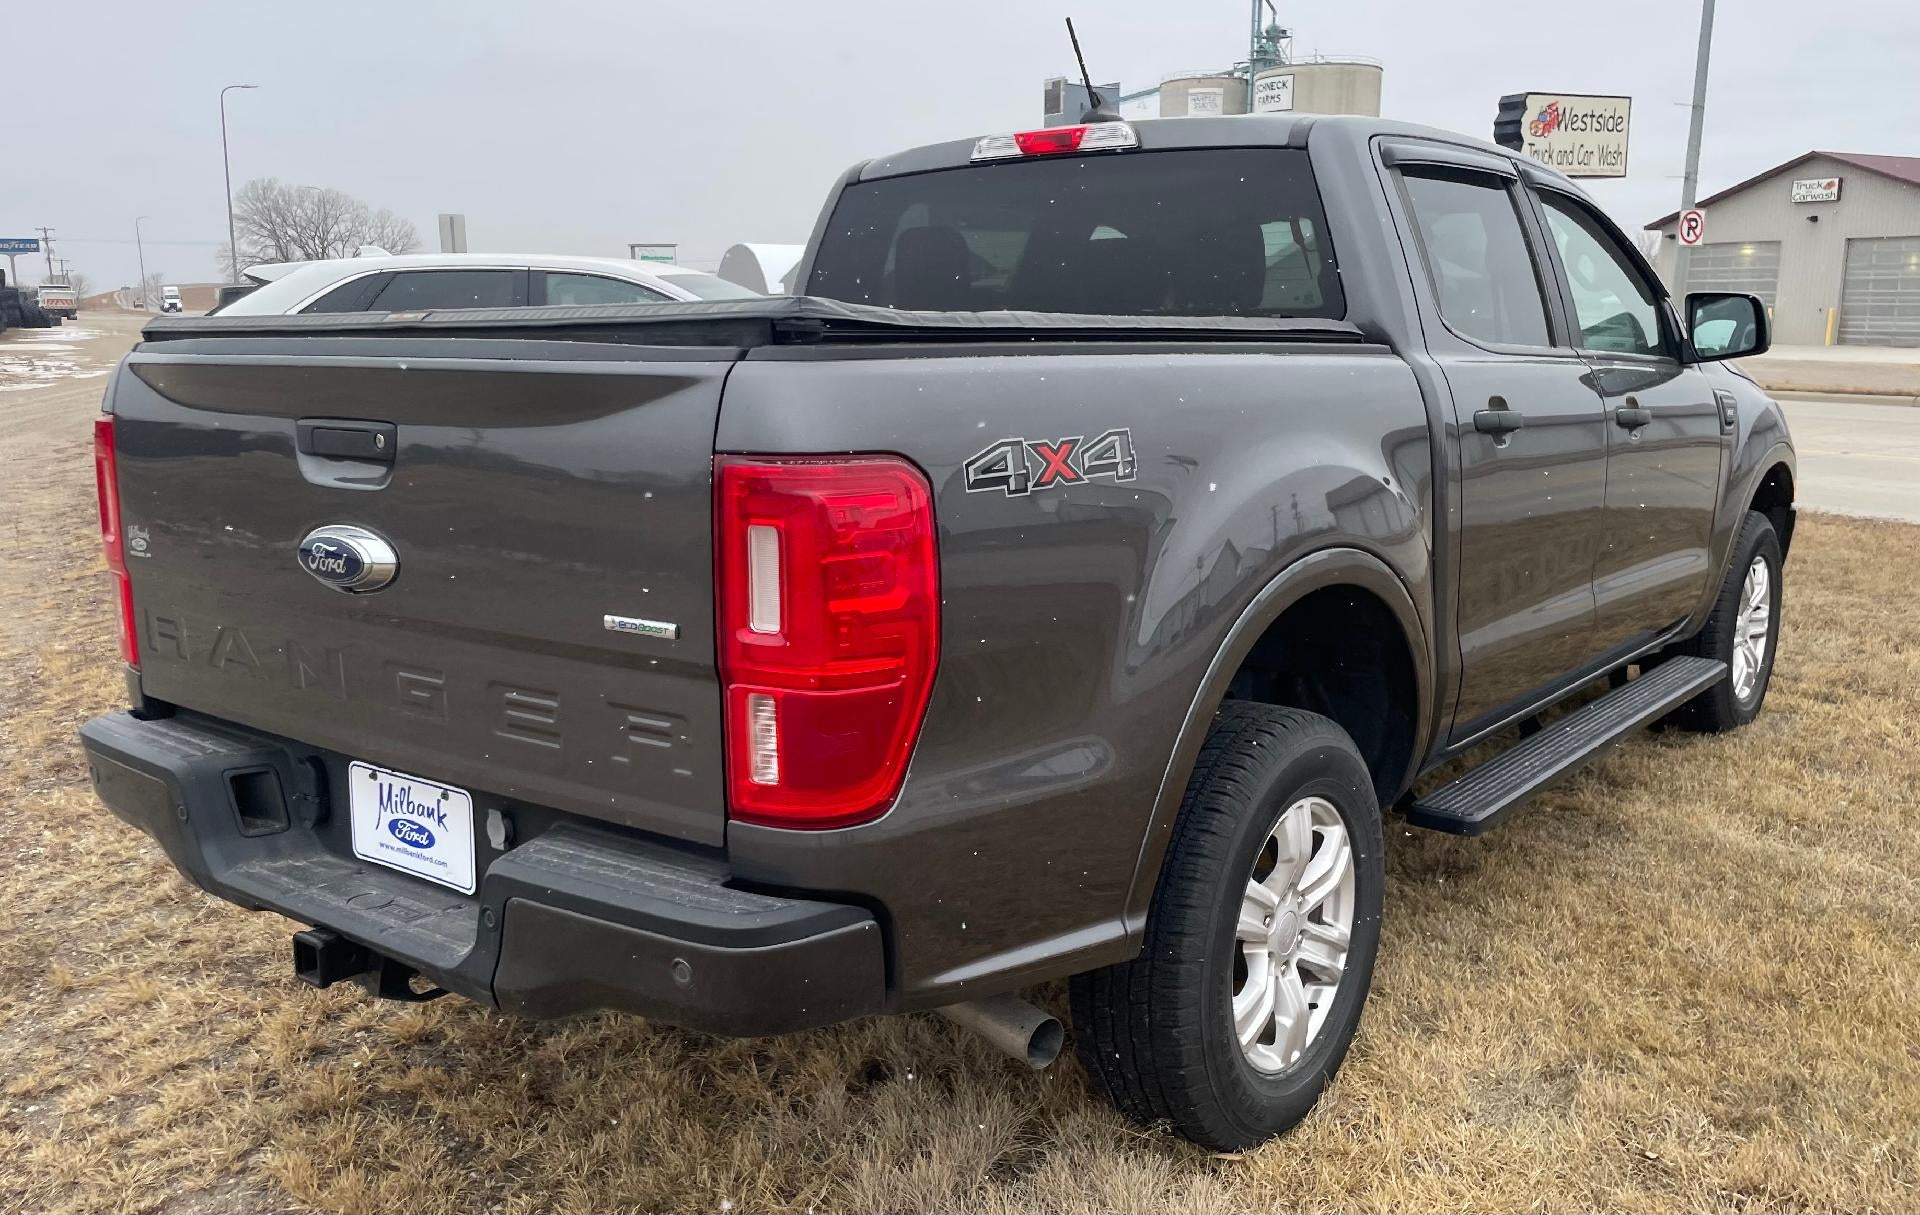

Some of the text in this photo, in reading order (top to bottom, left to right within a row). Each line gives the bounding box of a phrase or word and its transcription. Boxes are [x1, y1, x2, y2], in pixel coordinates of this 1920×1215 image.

[1258, 95, 1281, 105] FARMS
[1558, 106, 1624, 133] Westside
[1528, 142, 1623, 167] Truck and Car Wash
[1795, 181, 1823, 190] Truck
[1687, 217, 1699, 238] P
[308, 542, 348, 574] Ford
[142, 614, 693, 776] RANGER
[376, 782, 449, 832] Milbank
[395, 820, 431, 846] Ford
[379, 841, 448, 868] www.milbankford.com
